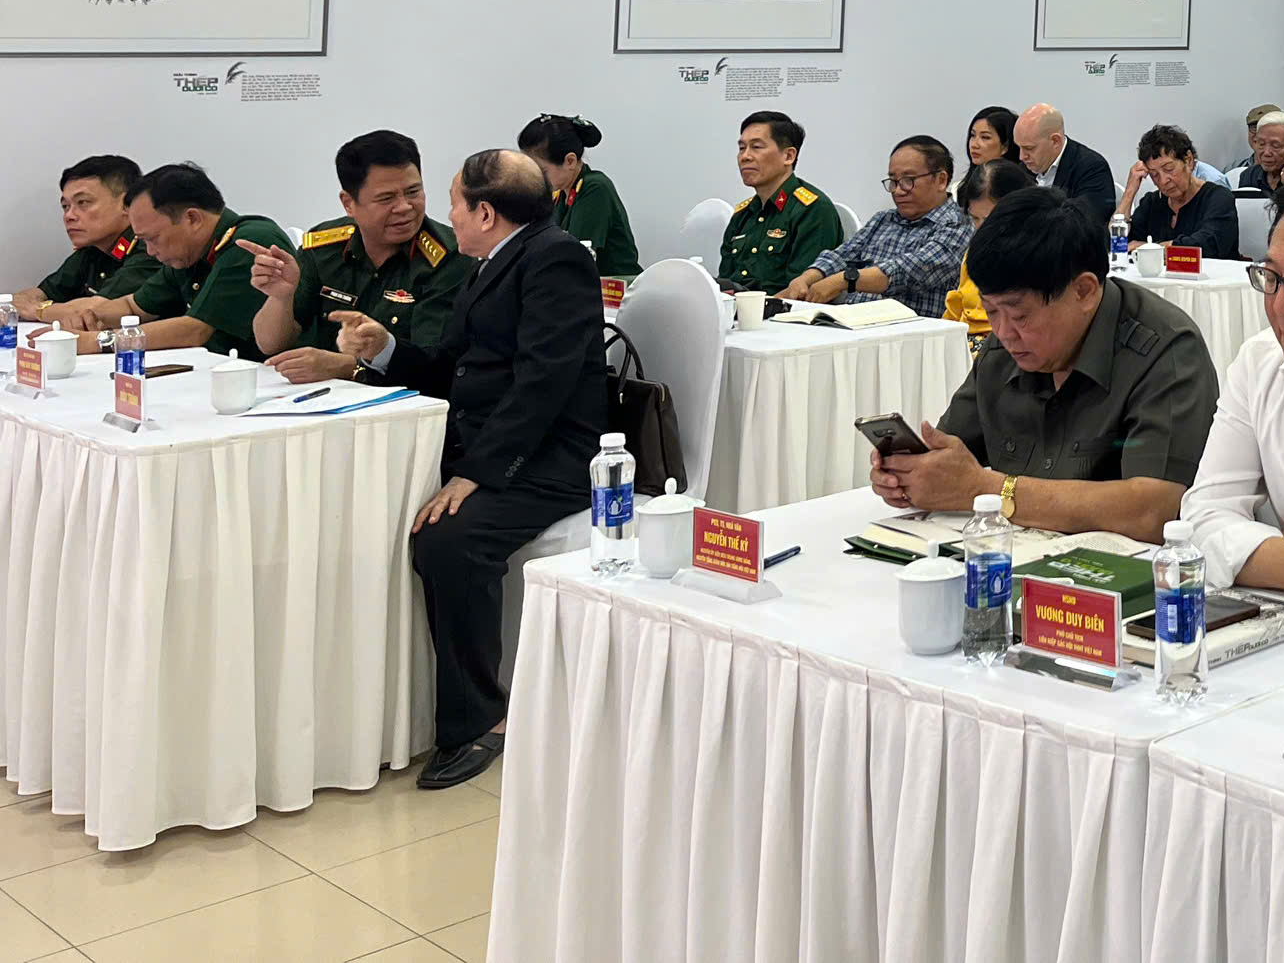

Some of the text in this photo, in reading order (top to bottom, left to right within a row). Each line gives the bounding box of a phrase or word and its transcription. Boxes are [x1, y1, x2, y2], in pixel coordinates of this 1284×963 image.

[728, 535, 740, 550] THẾ
[1036, 604, 1104, 633] VƯƠNG DUY BIÊN
